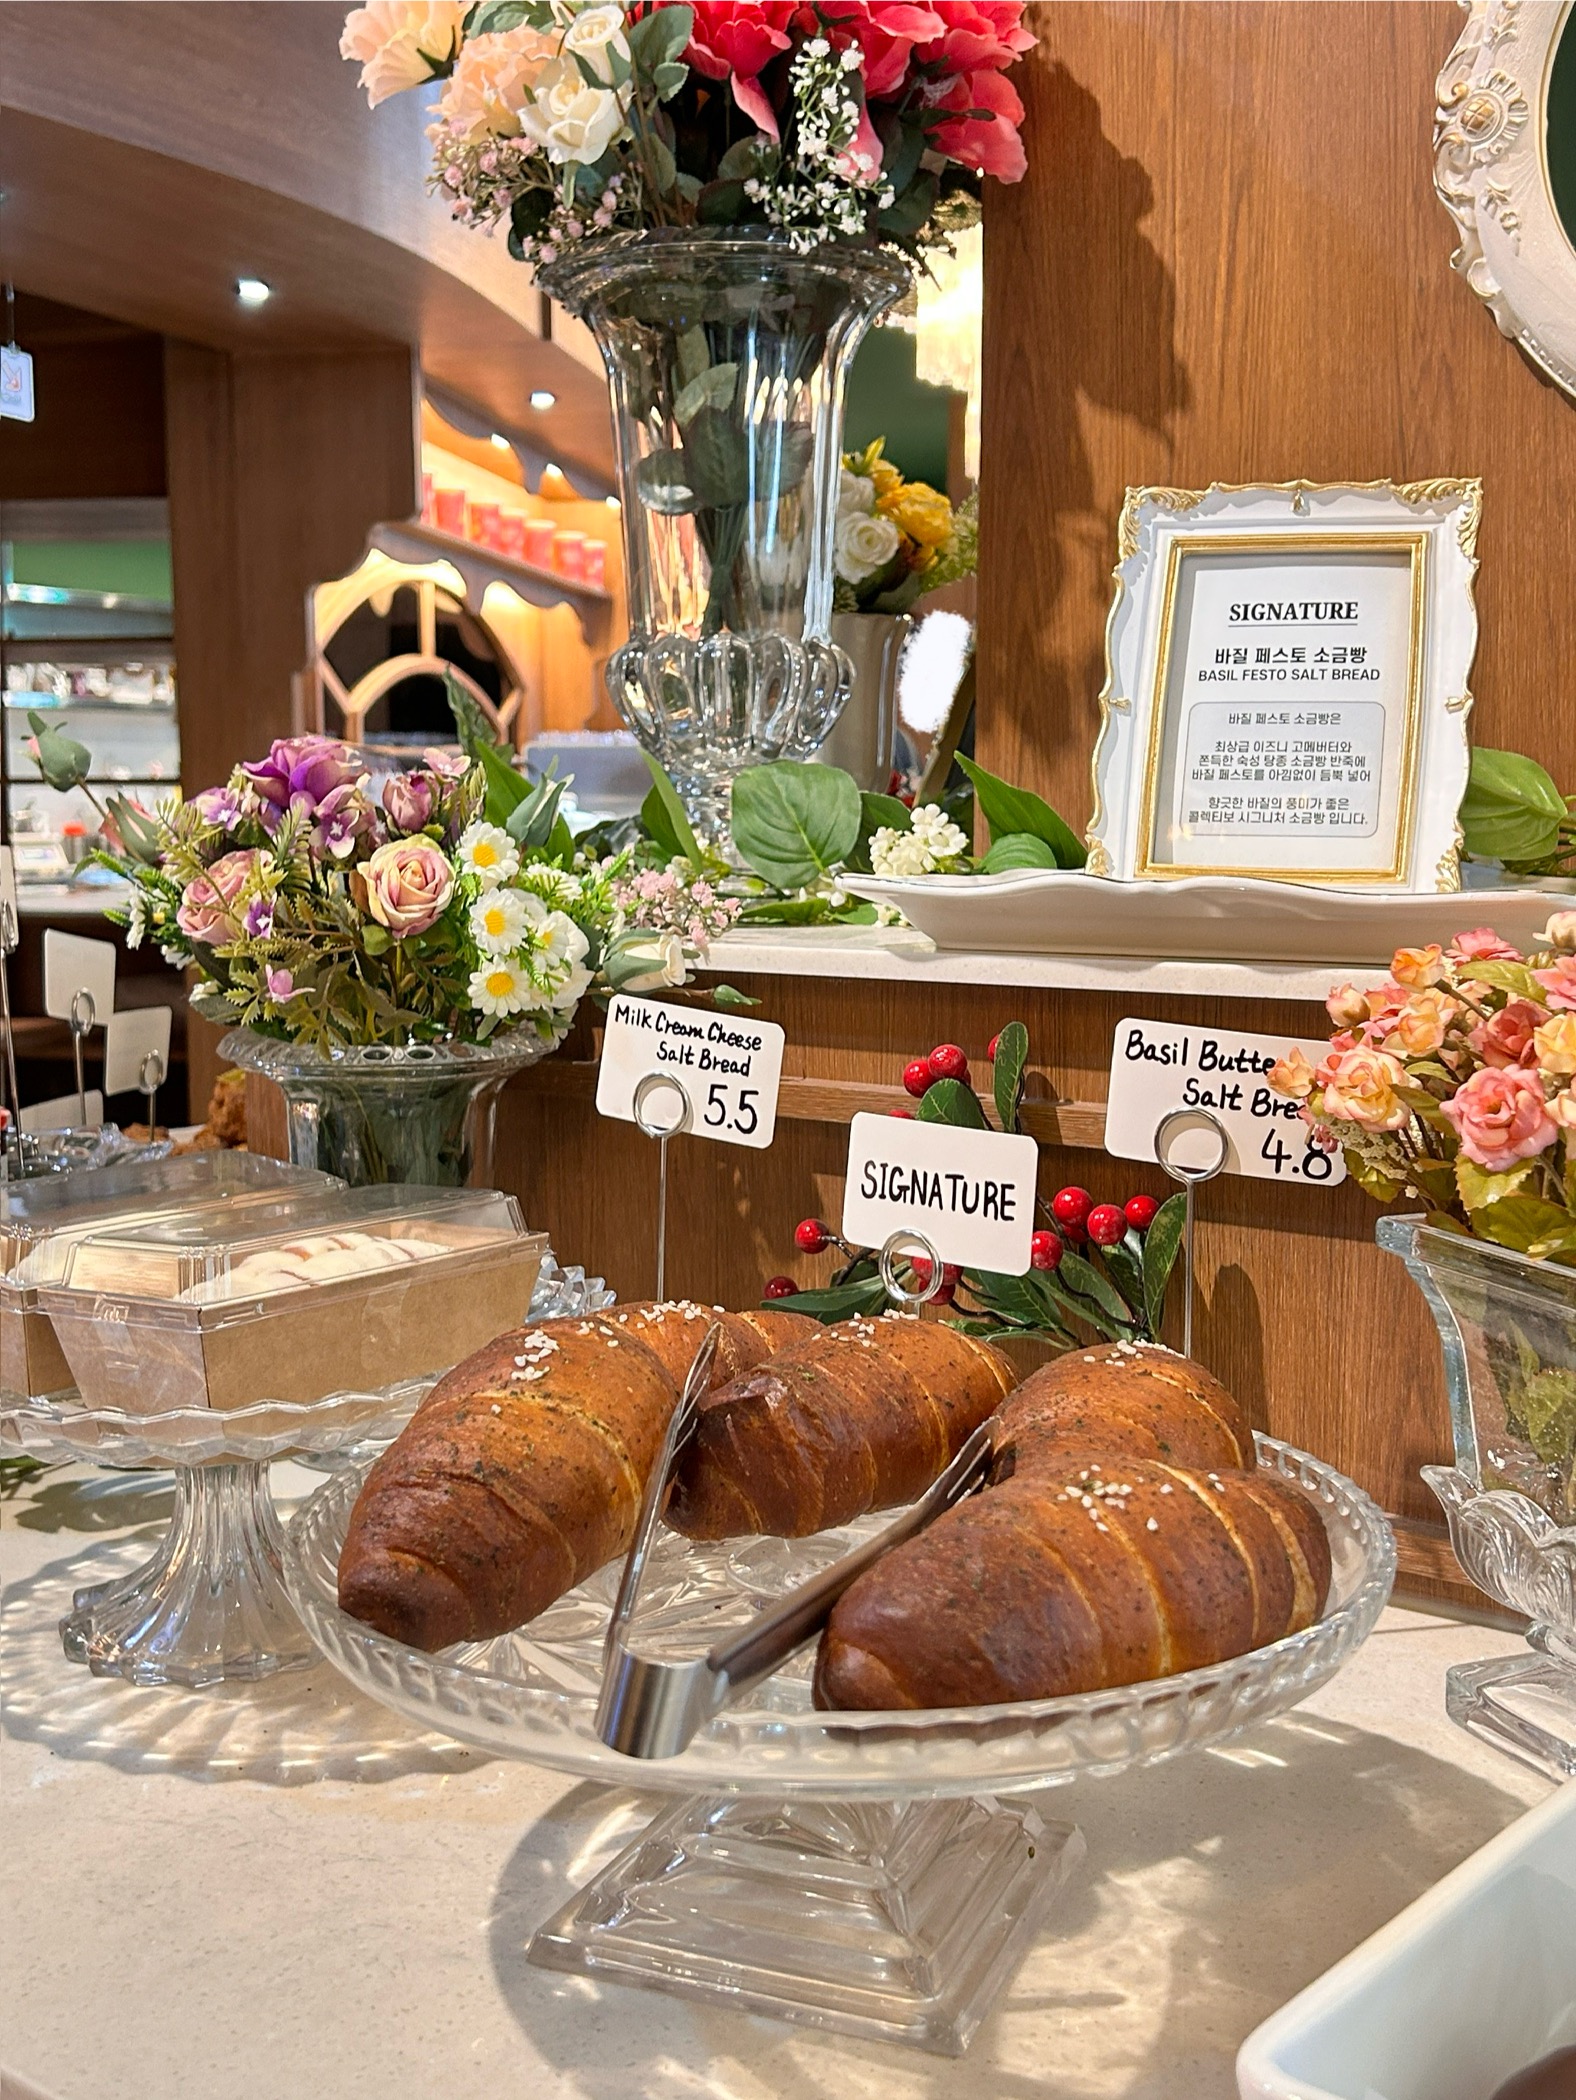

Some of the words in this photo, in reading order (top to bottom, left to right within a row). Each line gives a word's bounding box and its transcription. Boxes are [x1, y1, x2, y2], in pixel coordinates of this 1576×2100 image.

[1229, 602, 1359, 622] SIGNATURE
[1215, 647, 1248, 665] 바질
[1255, 647, 1306, 664] 페스토
[1314, 646, 1367, 664] 소금빵
[1198, 669, 1238, 682] BASIL
[1242, 669, 1287, 681] FESTO
[1291, 668, 1328, 681] SALT
[1331, 668, 1380, 681] BREAD
[1229, 713, 1251, 725] 바질
[1255, 713, 1290, 725] 페스토
[1294, 713, 1341, 725] 소금빵은
[1215, 741, 1249, 753] 최상급
[1253, 741, 1288, 753] 이즈니
[1292, 741, 1352, 753] 고메버터와
[1198, 755, 1233, 767] 쫀득한
[1237, 755, 1260, 767] 숙성
[1291, 755, 1326, 767] 소금빵
[1330, 755, 1366, 767] 반죽에
[1192, 769, 1214, 781] 바질
[1268, 769, 1315, 781] 아낌없이
[1208, 796, 1243, 809] 향긋한
[1247, 796, 1282, 809] 바질의
[1286, 797, 1322, 810] 풍미가
[1325, 798, 1350, 810] 좋은
[1189, 810, 1234, 823] 콜렉티보
[1238, 810, 1285, 823] 시그니처
[1289, 811, 1325, 824] 소금빵
[1329, 811, 1368, 825] 입니다.
[615, 1004, 652, 1029] Milk
[655, 1011, 704, 1040] Cream
[707, 1021, 762, 1051] Cheese
[656, 1040, 695, 1066] Salt
[699, 1048, 752, 1077] Bread
[1125, 1029, 1189, 1067] Basil
[1198, 1040, 1276, 1076] Butte
[1183, 1078, 1243, 1111] Salt
[1250, 1088, 1307, 1120] Bre
[704, 1084, 759, 1134] 5.5
[1261, 1128, 1332, 1181] 4.8
[861, 1160, 1016, 1221] SIGNATURE
